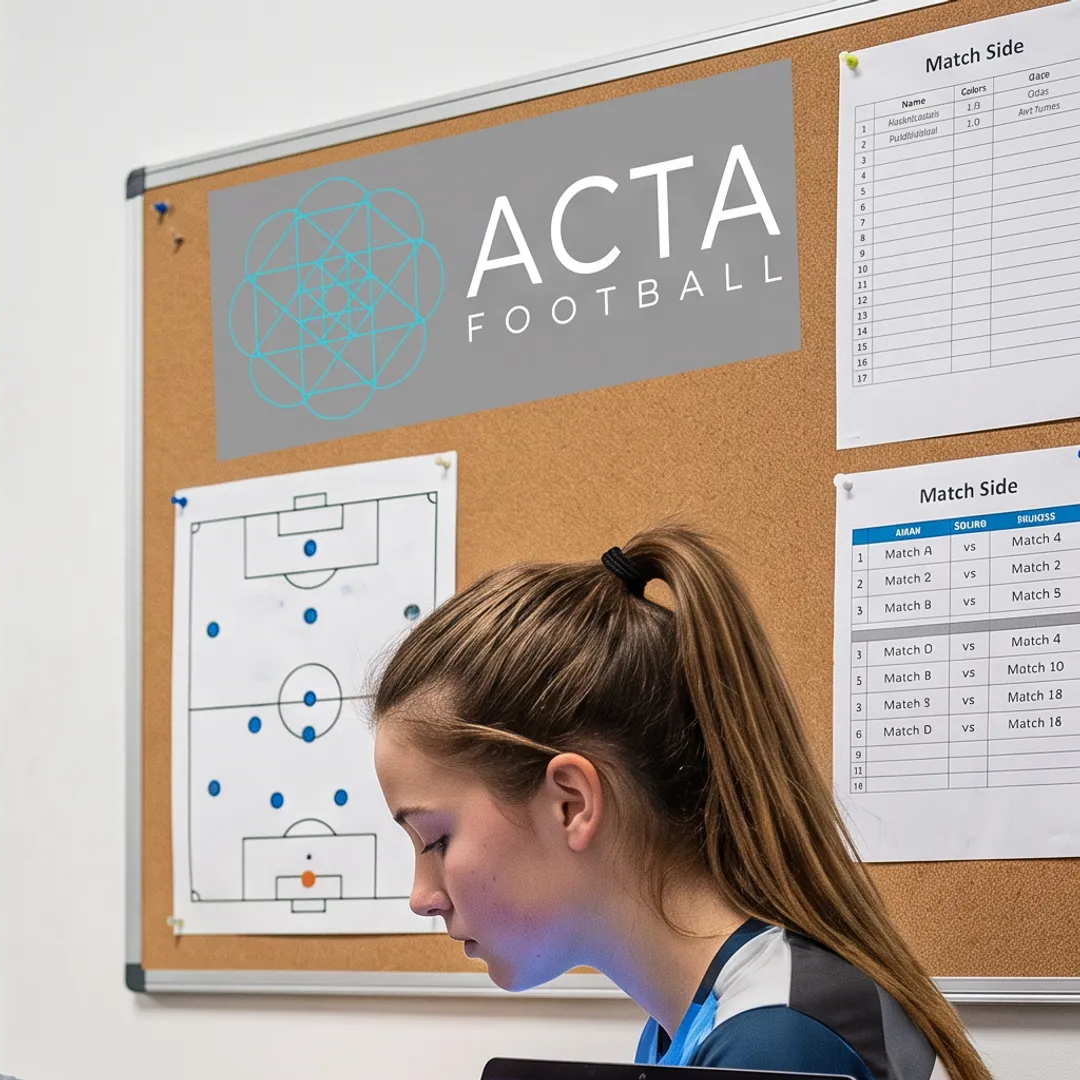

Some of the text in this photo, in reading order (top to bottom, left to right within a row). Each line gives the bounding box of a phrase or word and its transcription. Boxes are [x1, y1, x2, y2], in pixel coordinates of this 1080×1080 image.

[926, 40, 1024, 73] Match Side
[901, 97, 927, 109] Name
[862, 124, 866, 134] 1
[861, 140, 867, 150] 2
[861, 155, 866, 165] 3
[861, 171, 866, 181] 4
[860, 187, 866, 197] 5
[860, 202, 866, 212] 6
[466, 143, 781, 299] ACTA
[860, 217, 865, 227] 7
[859, 233, 865, 243] 8
[859, 249, 865, 259] 9
[857, 264, 869, 274] 10
[857, 280, 869, 290] 11
[467, 255, 783, 342] FOOTBALL
[857, 295, 869, 305] 12
[857, 311, 869, 321] 13
[857, 326, 869, 336] 14
[857, 342, 869, 352] 15
[857, 358, 869, 368] 16
[857, 373, 869, 383] 17
[920, 478, 1018, 505] Match Side
[858, 553, 863, 563] 1
[885, 547, 921, 559] Match
[964, 543, 976, 551] vs
[1012, 533, 1050, 547] Match
[1054, 532, 1062, 543] 4
[857, 560, 1062, 589] 2 Match 2 vs Match 2
[857, 606, 863, 615] 3
[884, 600, 921, 613] Match
[963, 597, 976, 606] vs
[1012, 588, 1050, 602] Match
[1054, 587, 1062, 598] 5
[857, 650, 862, 659] 3
[884, 645, 921, 657] Match
[962, 642, 975, 651] vs
[1012, 634, 1050, 647] Match
[1053, 633, 1062, 644] 4
[856, 676, 862, 685] 5
[884, 671, 921, 683] Match
[962, 669, 975, 678] vs
[1050, 661, 1065, 672] 10
[856, 703, 862, 712] 3
[962, 697, 975, 705] vs
[1008, 690, 1044, 703] Match
[1049, 689, 1063, 700] 18
[856, 730, 862, 739] 6
[883, 725, 920, 737] Match
[924, 725, 932, 735] D
[962, 724, 975, 732] vs
[1009, 718, 1045, 729] Match
[856, 751, 861, 759] 9
